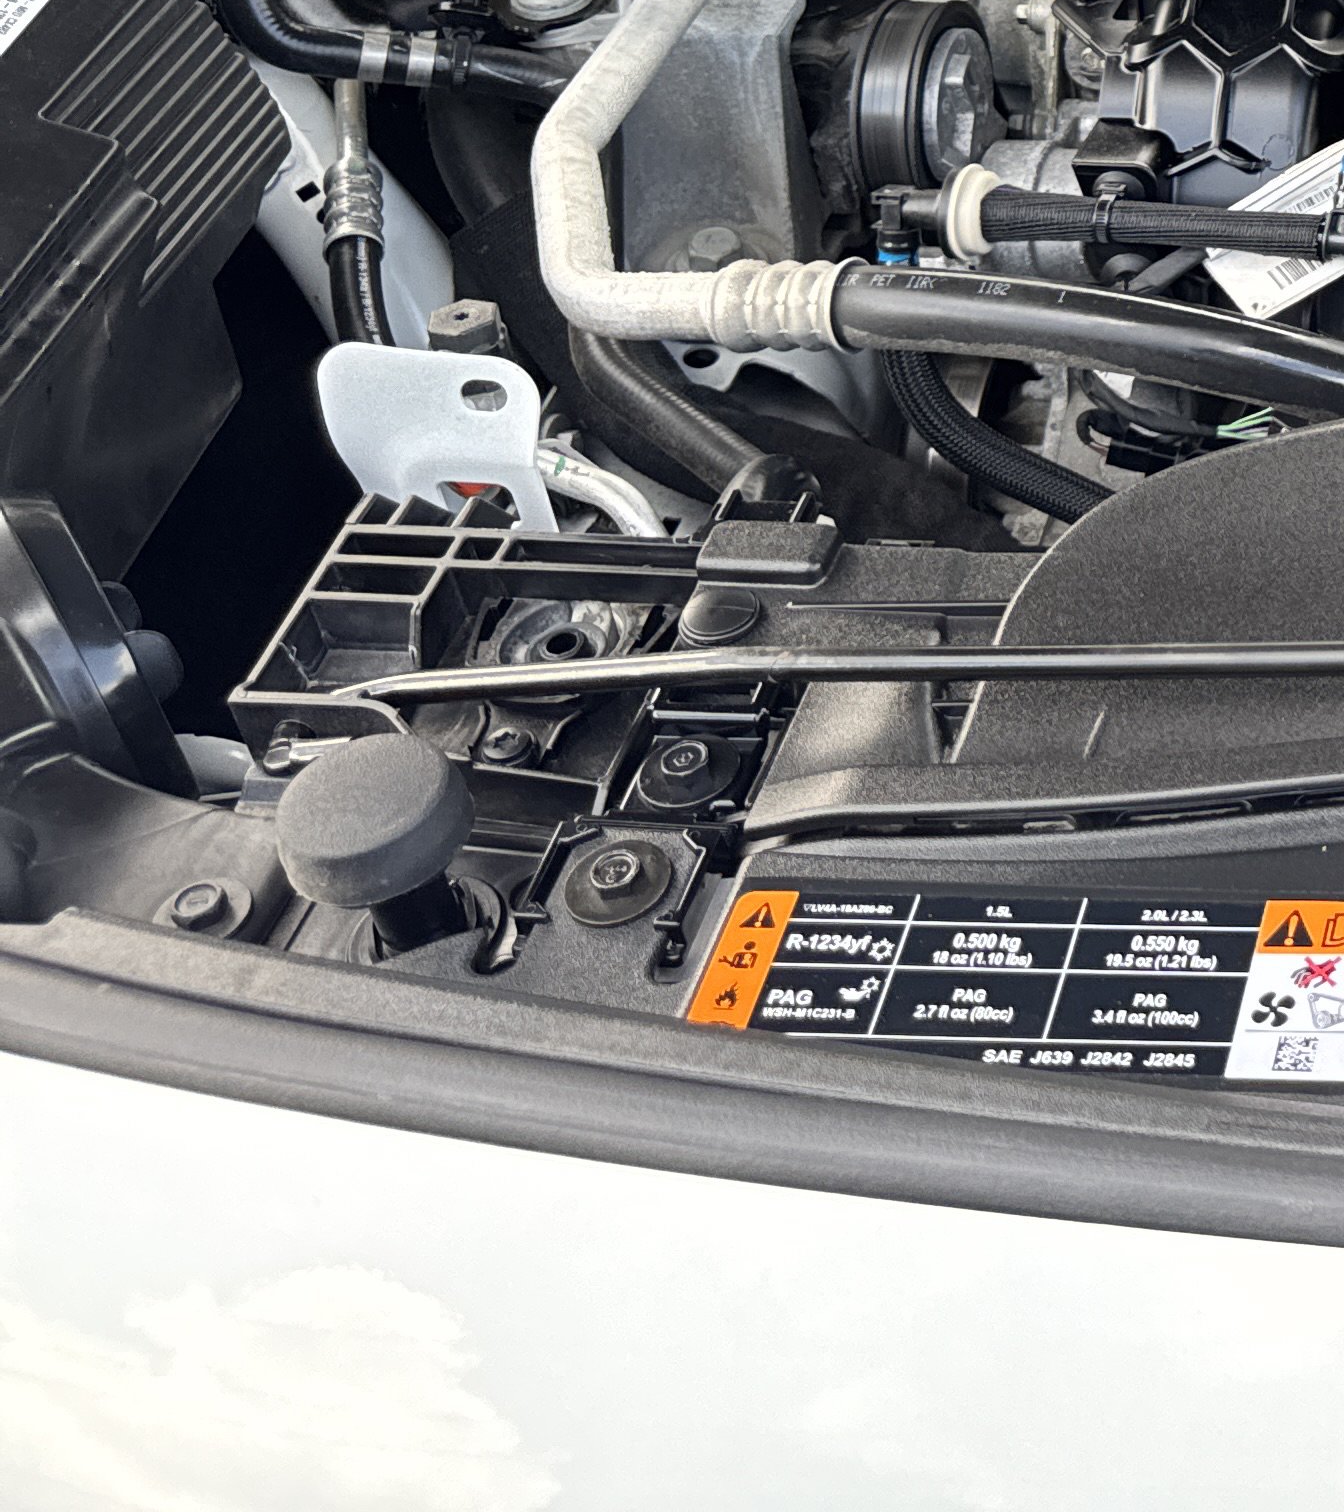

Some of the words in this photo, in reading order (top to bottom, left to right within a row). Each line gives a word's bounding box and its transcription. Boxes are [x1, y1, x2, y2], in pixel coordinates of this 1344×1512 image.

[869, 273, 896, 287] PET
[986, 905, 1013, 918] 1.5L
[1141, 909, 1170, 922] 2.0L
[1179, 910, 1208, 923] 2.3L
[785, 933, 873, 956] R-1234yf
[952, 932, 998, 949] 0.500
[999, 933, 1022, 953] kg
[1130, 934, 1176, 951] 0.550
[1177, 935, 1200, 955] kg
[932, 950, 950, 964] 18
[950, 954, 969, 964] oz
[969, 952, 1005, 967] (1.10
[1004, 952, 1033, 968] lbs)
[1105, 953, 1135, 967] 19.5
[1135, 957, 1154, 968] oz
[1154, 954, 1188, 970] (1.21
[1189, 955, 1218, 971] lbs)
[766, 988, 814, 1006] PAG
[952, 988, 987, 1003] PAG
[1131, 993, 1168, 1008] PAG
[912, 1004, 938, 1019] 2.7
[937, 1004, 950, 1019] fl
[950, 1008, 970, 1020] oz
[970, 1006, 1014, 1024] (80cc)
[1091, 1009, 1115, 1024] 3.4
[1115, 1009, 1128, 1024] fl
[1127, 1013, 1147, 1025] oz
[1147, 1010, 1200, 1028] (100cc)
[982, 1049, 1023, 1064] SAE
[1029, 1050, 1074, 1065] J639
[1081, 1051, 1133, 1067] J2842
[1143, 1052, 1196, 1068] J2845
